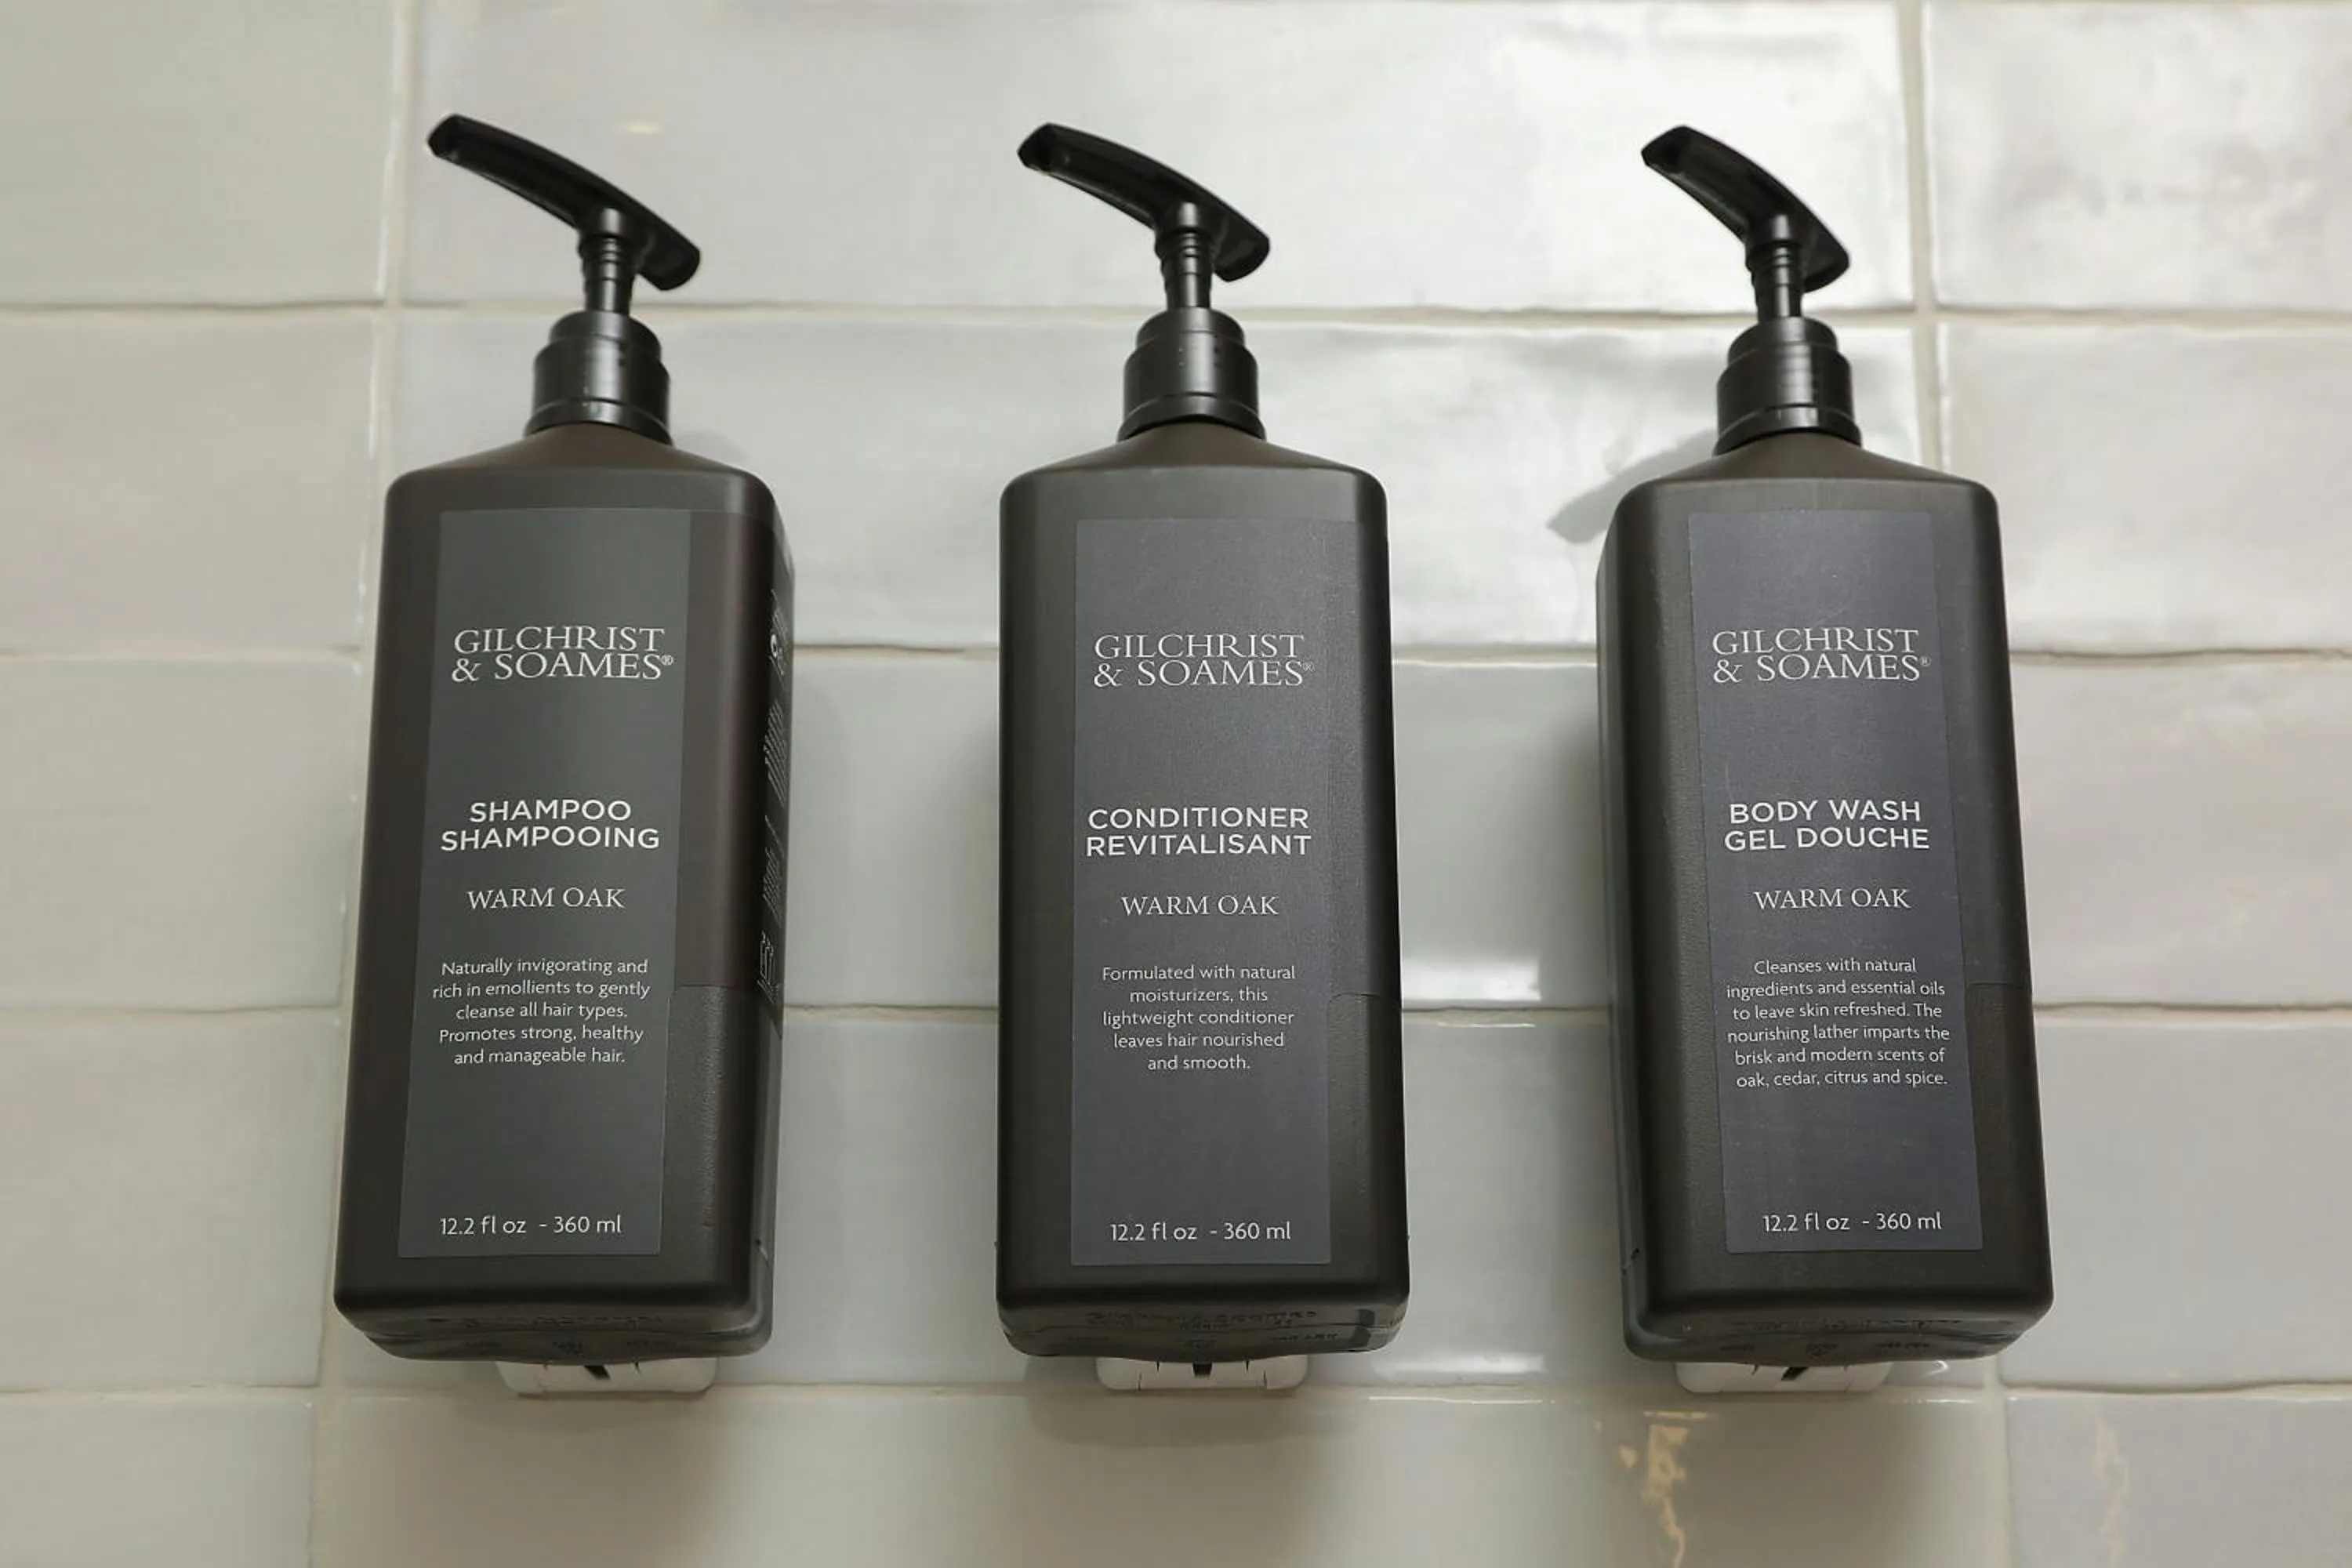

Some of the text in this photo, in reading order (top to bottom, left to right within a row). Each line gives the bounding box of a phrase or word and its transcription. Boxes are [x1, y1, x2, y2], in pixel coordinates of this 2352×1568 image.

[453, 625, 666, 655] GILCHRIST
[1094, 633, 1305, 659] GILCHRIST
[1711, 626, 1920, 656] GILCHRIST
[451, 658, 482, 683] &
[1093, 662, 1124, 688] &
[1712, 659, 1744, 684] &
[468, 799, 632, 823] SHAMPOO
[1087, 806, 1309, 830] CONDITIONER
[1729, 799, 1922, 824] BODY WASH
[440, 825, 659, 852] SHAMPOOING
[1086, 833, 1312, 857] REVITALISANT
[1724, 826, 1930, 852] GEL DOUCHE
[466, 887, 626, 910] WARM OAK
[1120, 894, 1279, 916] WARM OAK
[1752, 887, 1912, 910] WARM OAK
[441, 956, 648, 977] Naturally invigorating and
[1102, 964, 1296, 982] Formulated with natural
[1754, 956, 1917, 975] Cleanses with natural
[432, 978, 652, 1000] rich in emollients to gently
[1130, 985, 1269, 1004] moisturizers, this
[1726, 978, 1946, 1002] ingredients and essential oils
[456, 1000, 628, 1022] cleanse all hair types.
[1103, 1008, 1295, 1029] lightweight conditioner
[1732, 1000, 1943, 1020] to leave skin refreshed. The
[439, 1023, 644, 1045] Promotes strong, healthy
[1113, 1031, 1284, 1049] leaves hair nourished
[1727, 1023, 1951, 1044] nourishing lather imparts the
[454, 1046, 626, 1066] and manageable hair.
[1147, 1053, 1251, 1070] and smooth.
[1735, 1045, 1947, 1065] brisk and modern scents of
[1736, 1071, 1769, 1089] oak,
[1824, 1069, 1869, 1084] citrus
[1872, 1068, 1901, 1084] and
[1904, 1069, 1948, 1089] spice.
[440, 1217, 475, 1236] 12.2
[480, 1214, 496, 1235] fl
[502, 1220, 528, 1235] oz
[553, 1215, 590, 1233] 360
[596, 1214, 622, 1234] ml
[1109, 1223, 1146, 1242] 12.2
[1151, 1221, 1167, 1241] fl
[1173, 1227, 1198, 1242] oz
[1223, 1221, 1261, 1240] 360
[1266, 1220, 1291, 1240] ml
[1762, 1214, 1799, 1232] 12.2
[1804, 1211, 1820, 1231] fl
[1826, 1218, 1851, 1231] oz
[1875, 1212, 1912, 1230] 360
[1917, 1210, 1942, 1230] ml
